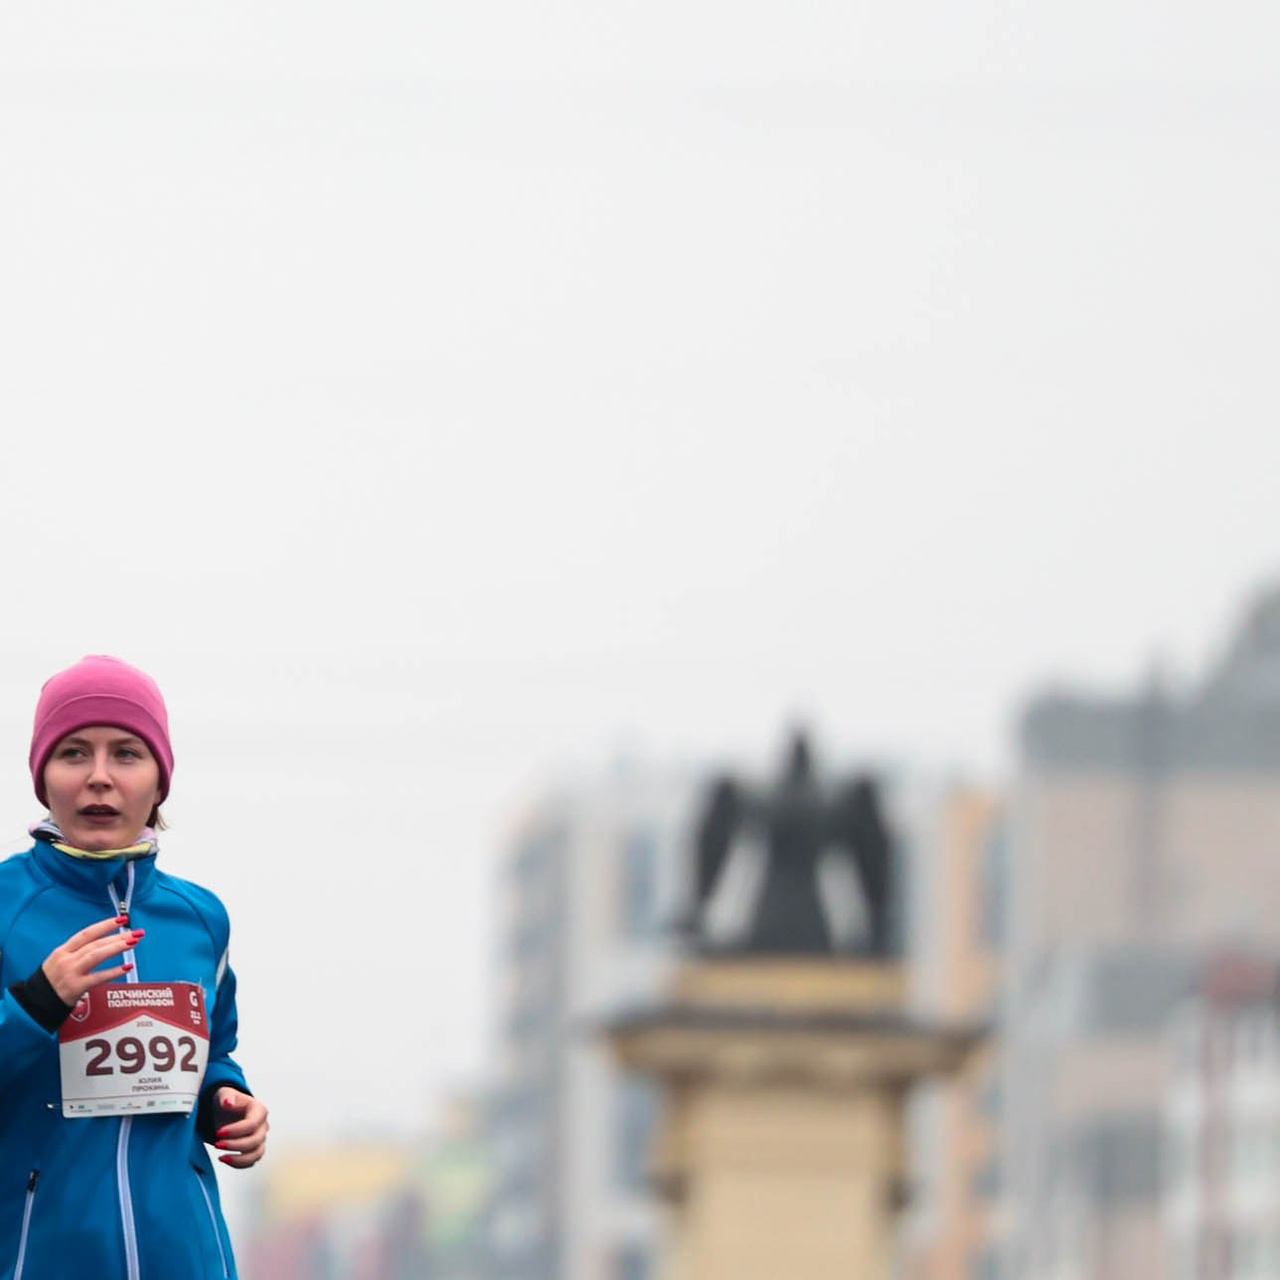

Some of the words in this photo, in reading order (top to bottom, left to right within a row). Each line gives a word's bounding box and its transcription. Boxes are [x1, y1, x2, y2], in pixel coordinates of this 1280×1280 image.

[106, 987, 173, 1000] ГАТЧИНСКИЙ
[108, 998, 174, 1008] ПОЛУМАРАФОН
[85, 1035, 199, 1076] 2992
